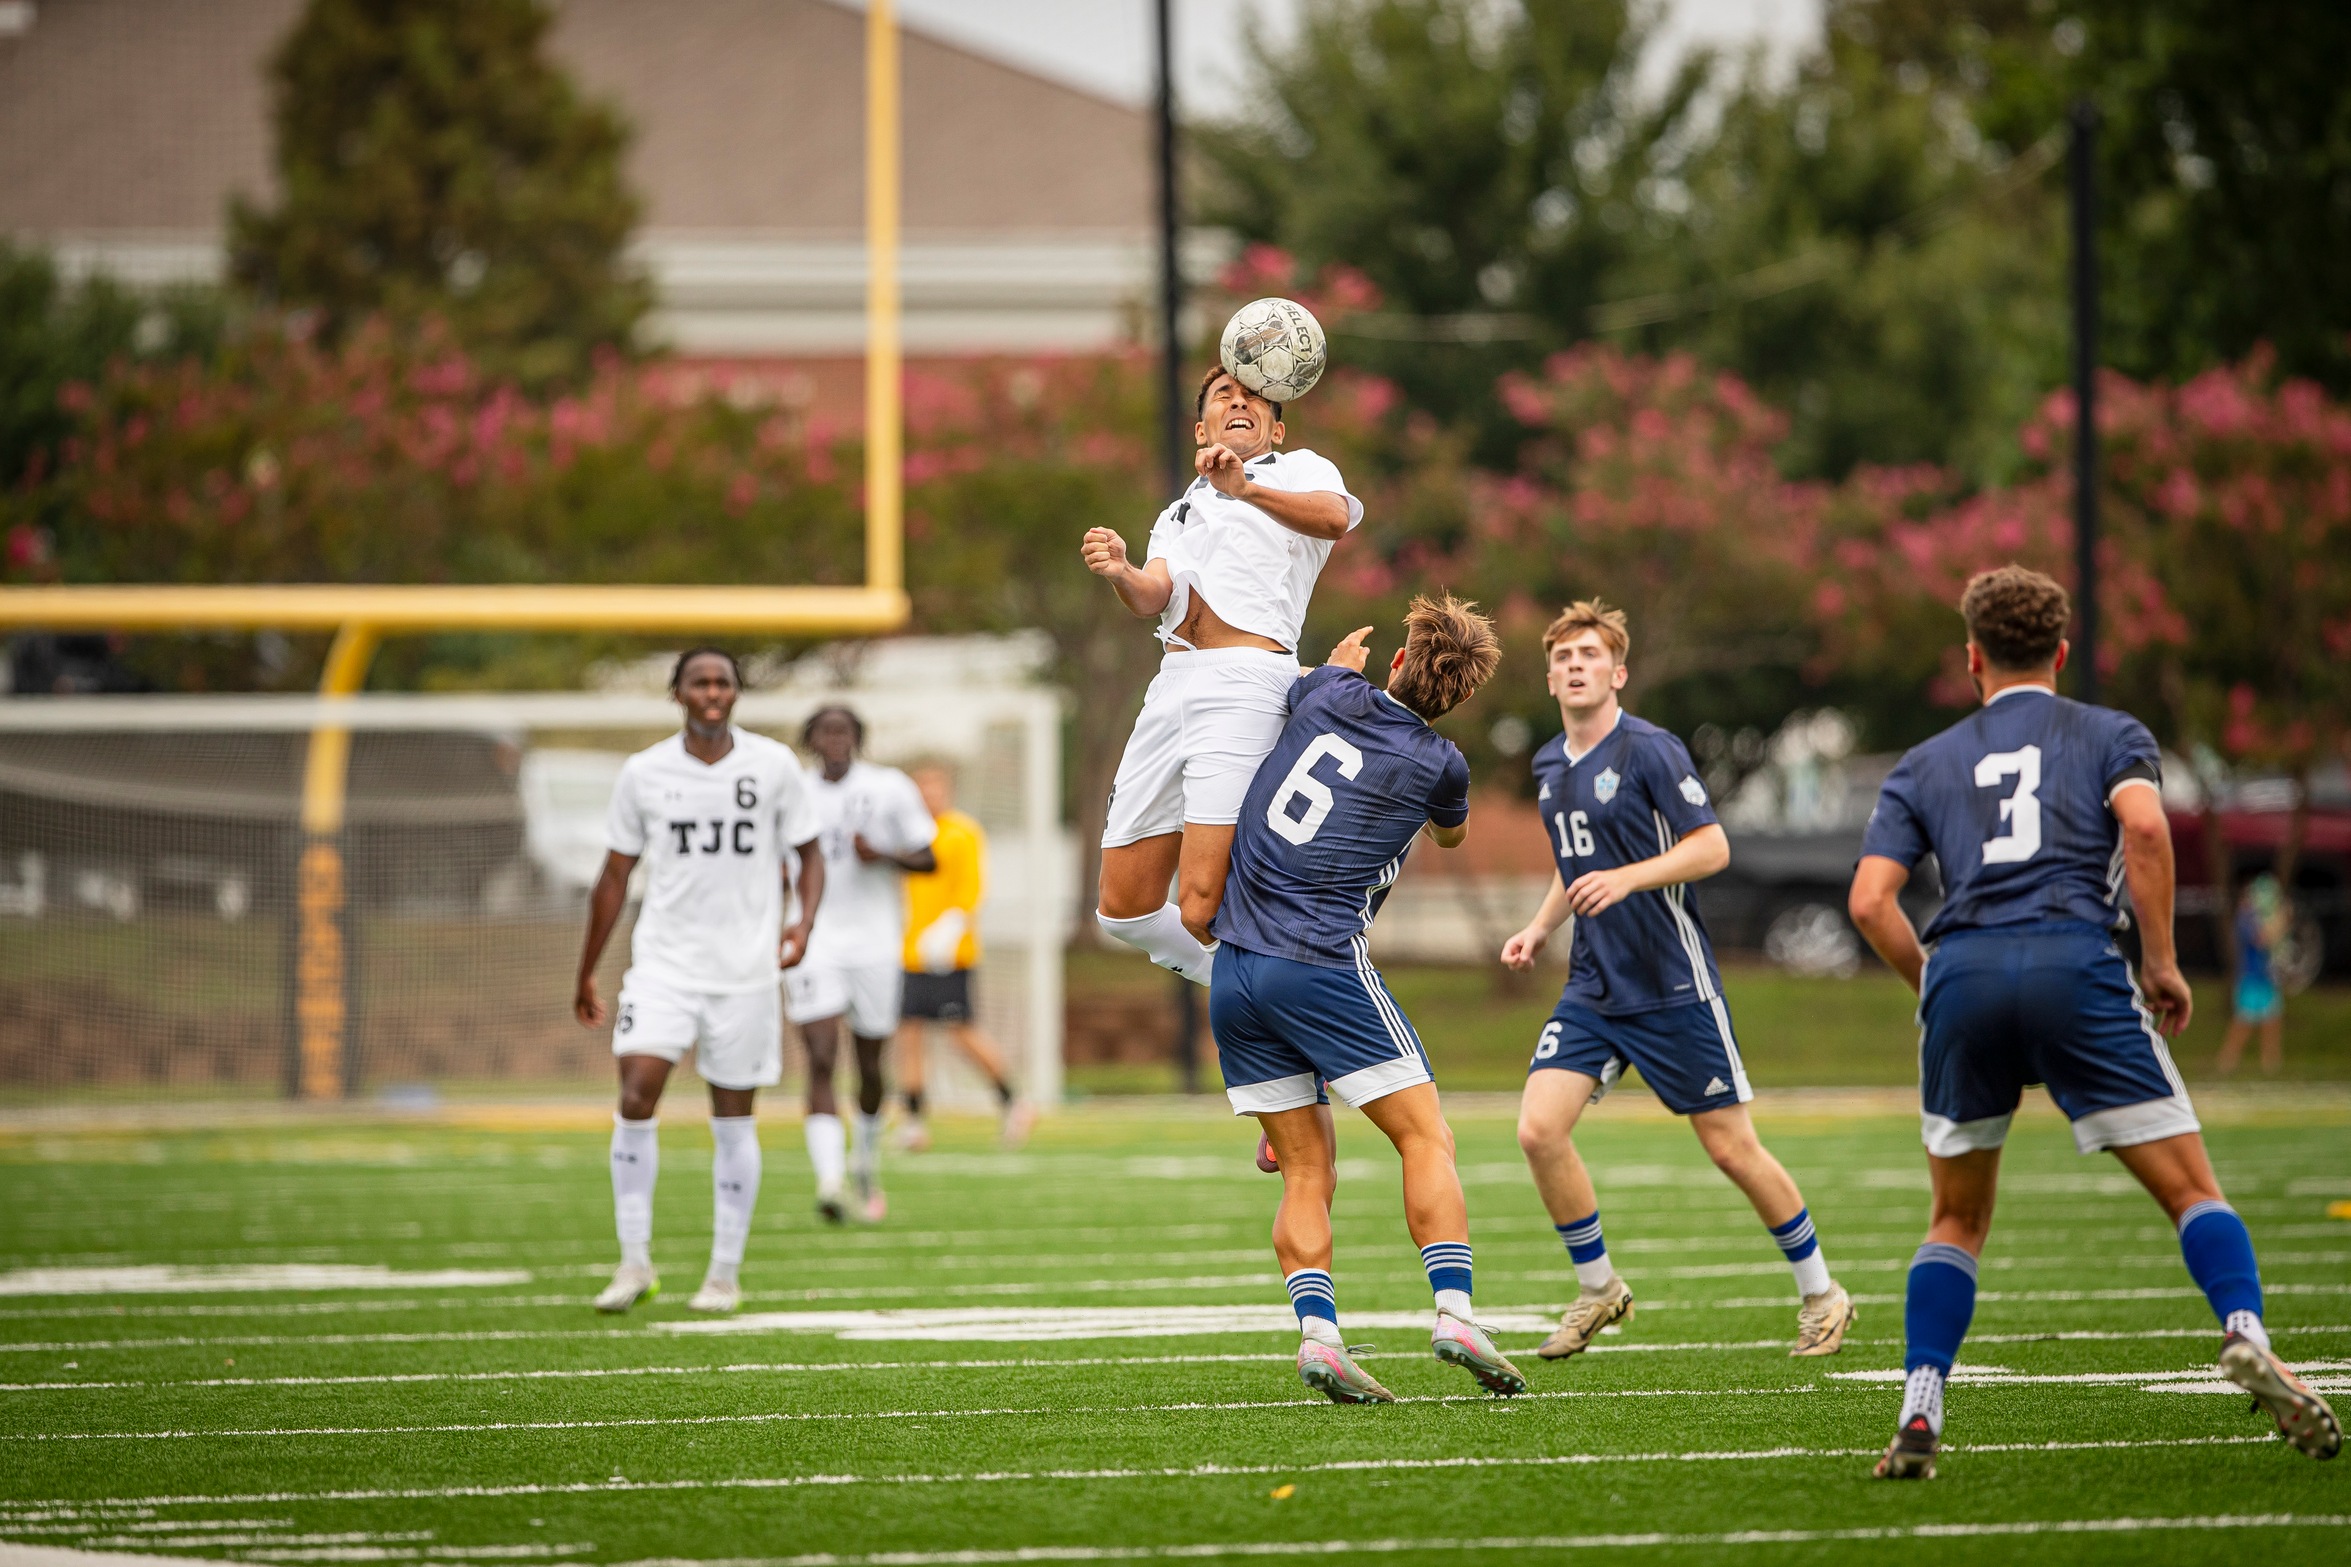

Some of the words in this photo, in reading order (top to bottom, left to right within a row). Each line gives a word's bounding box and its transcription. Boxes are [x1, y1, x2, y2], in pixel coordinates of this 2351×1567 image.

[1281, 304, 1312, 353] SELECT
[735, 776, 758, 809] 6
[1266, 732, 1363, 846] 6
[1974, 743, 2041, 866] 3
[669, 820, 755, 856] TJC
[1554, 810, 1596, 858] 16
[1530, 1021, 1563, 1066] 6
